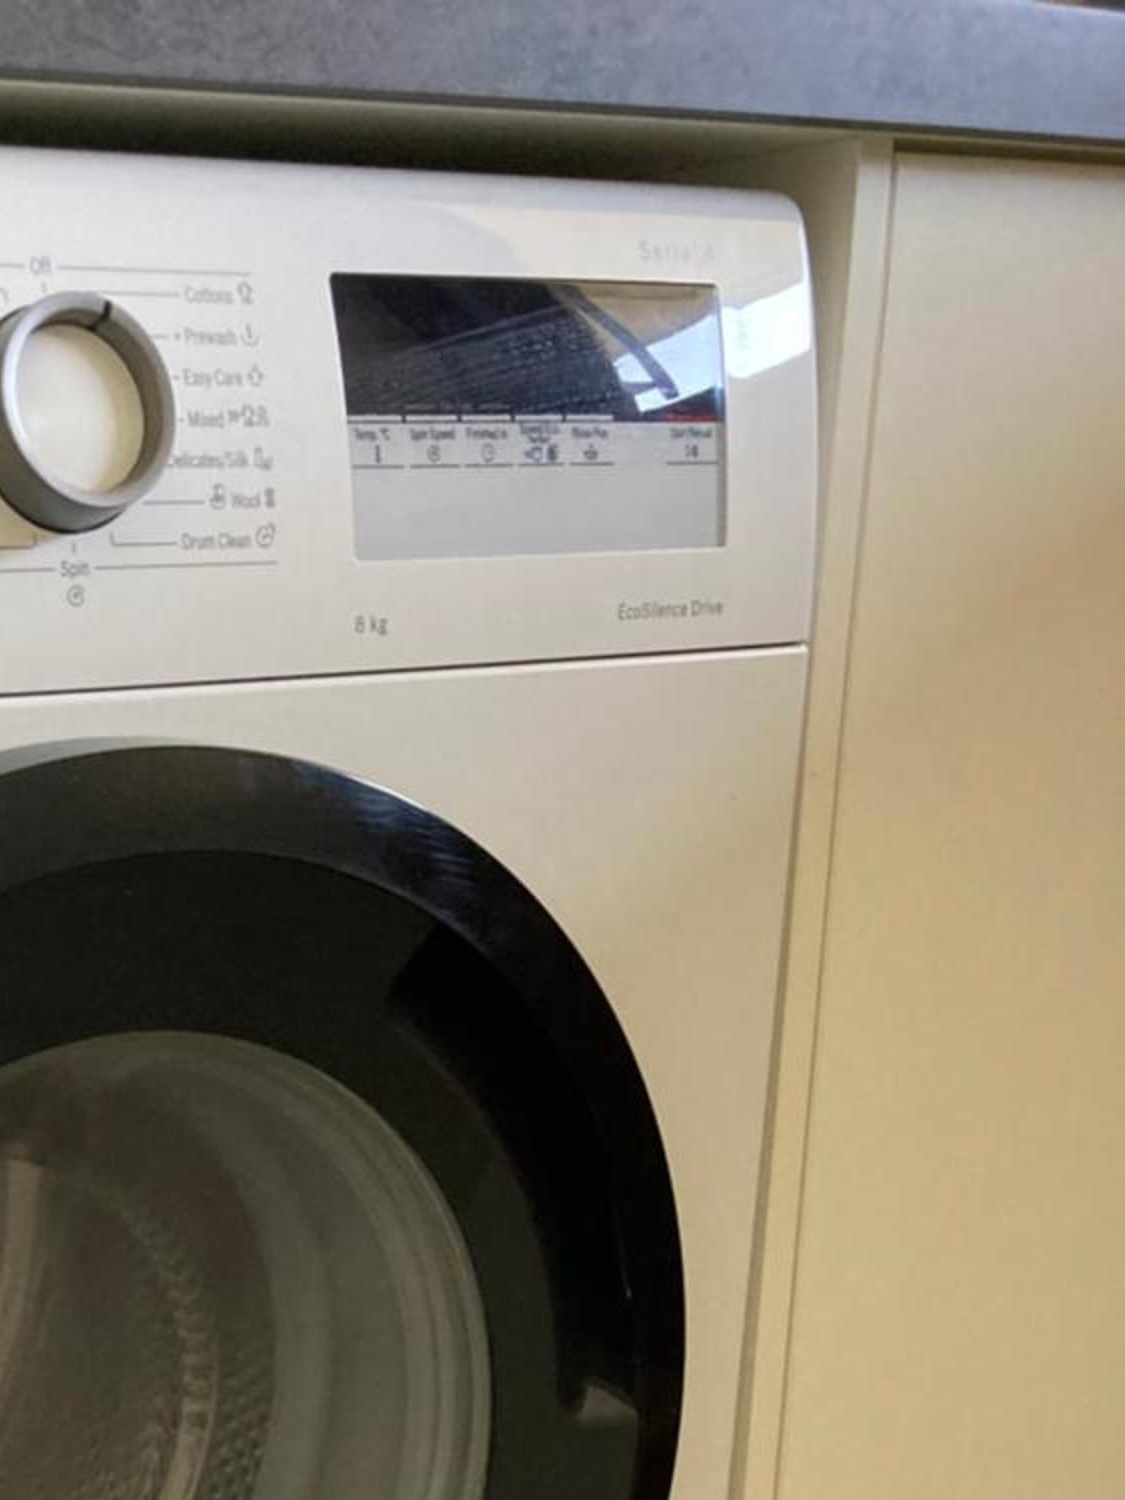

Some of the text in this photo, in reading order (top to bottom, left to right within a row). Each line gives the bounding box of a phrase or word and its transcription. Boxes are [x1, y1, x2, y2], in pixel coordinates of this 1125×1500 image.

[28, 256, 54, 276] Off
[183, 285, 234, 305] Cottons
[183, 328, 237, 346] Prewash
[182, 369, 243, 389] Easy Care
[187, 409, 224, 428] Mixed
[229, 493, 261, 509] Wool
[181, 531, 253, 550] Drum Clean
[60, 560, 91, 578] Spin
[617, 600, 725, 622] EcoSilence Drive
[354, 614, 389, 636] 8 kg
